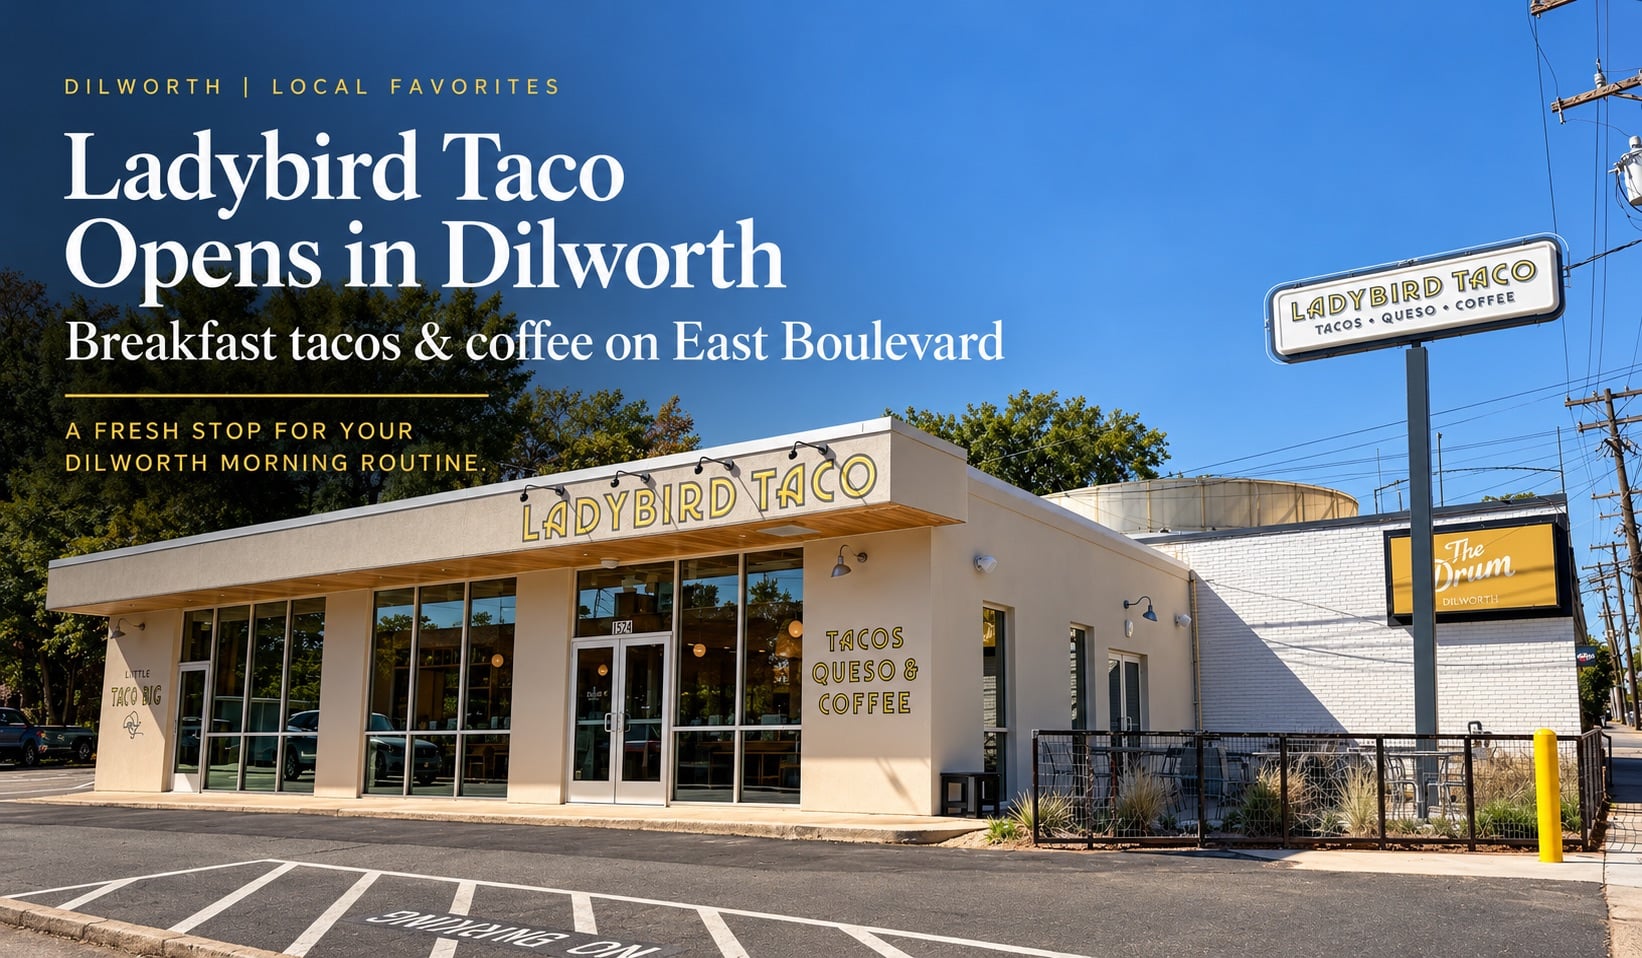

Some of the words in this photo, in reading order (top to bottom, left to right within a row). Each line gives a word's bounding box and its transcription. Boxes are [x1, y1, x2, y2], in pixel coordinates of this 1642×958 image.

[1291, 276, 1443, 322] LADYBIRD
[1452, 259, 1536, 292] TACO
[1315, 318, 1362, 335] TACOS
[1382, 305, 1435, 324] QUESO
[1456, 291, 1515, 311] COFFEE
[522, 476, 737, 543] LADYBIRD
[752, 453, 877, 512] TACO
[1445, 537, 1485, 563] The
[1434, 555, 1515, 592] Drum
[1443, 594, 1499, 606] DILWORTH
[826, 626, 904, 652] TACOS
[812, 659, 896, 686] QUESO
[903, 658, 918, 681] &
[111, 686, 138, 707] TACO
[142, 684, 162, 706] BIG
[818, 691, 911, 715] COFFEE
